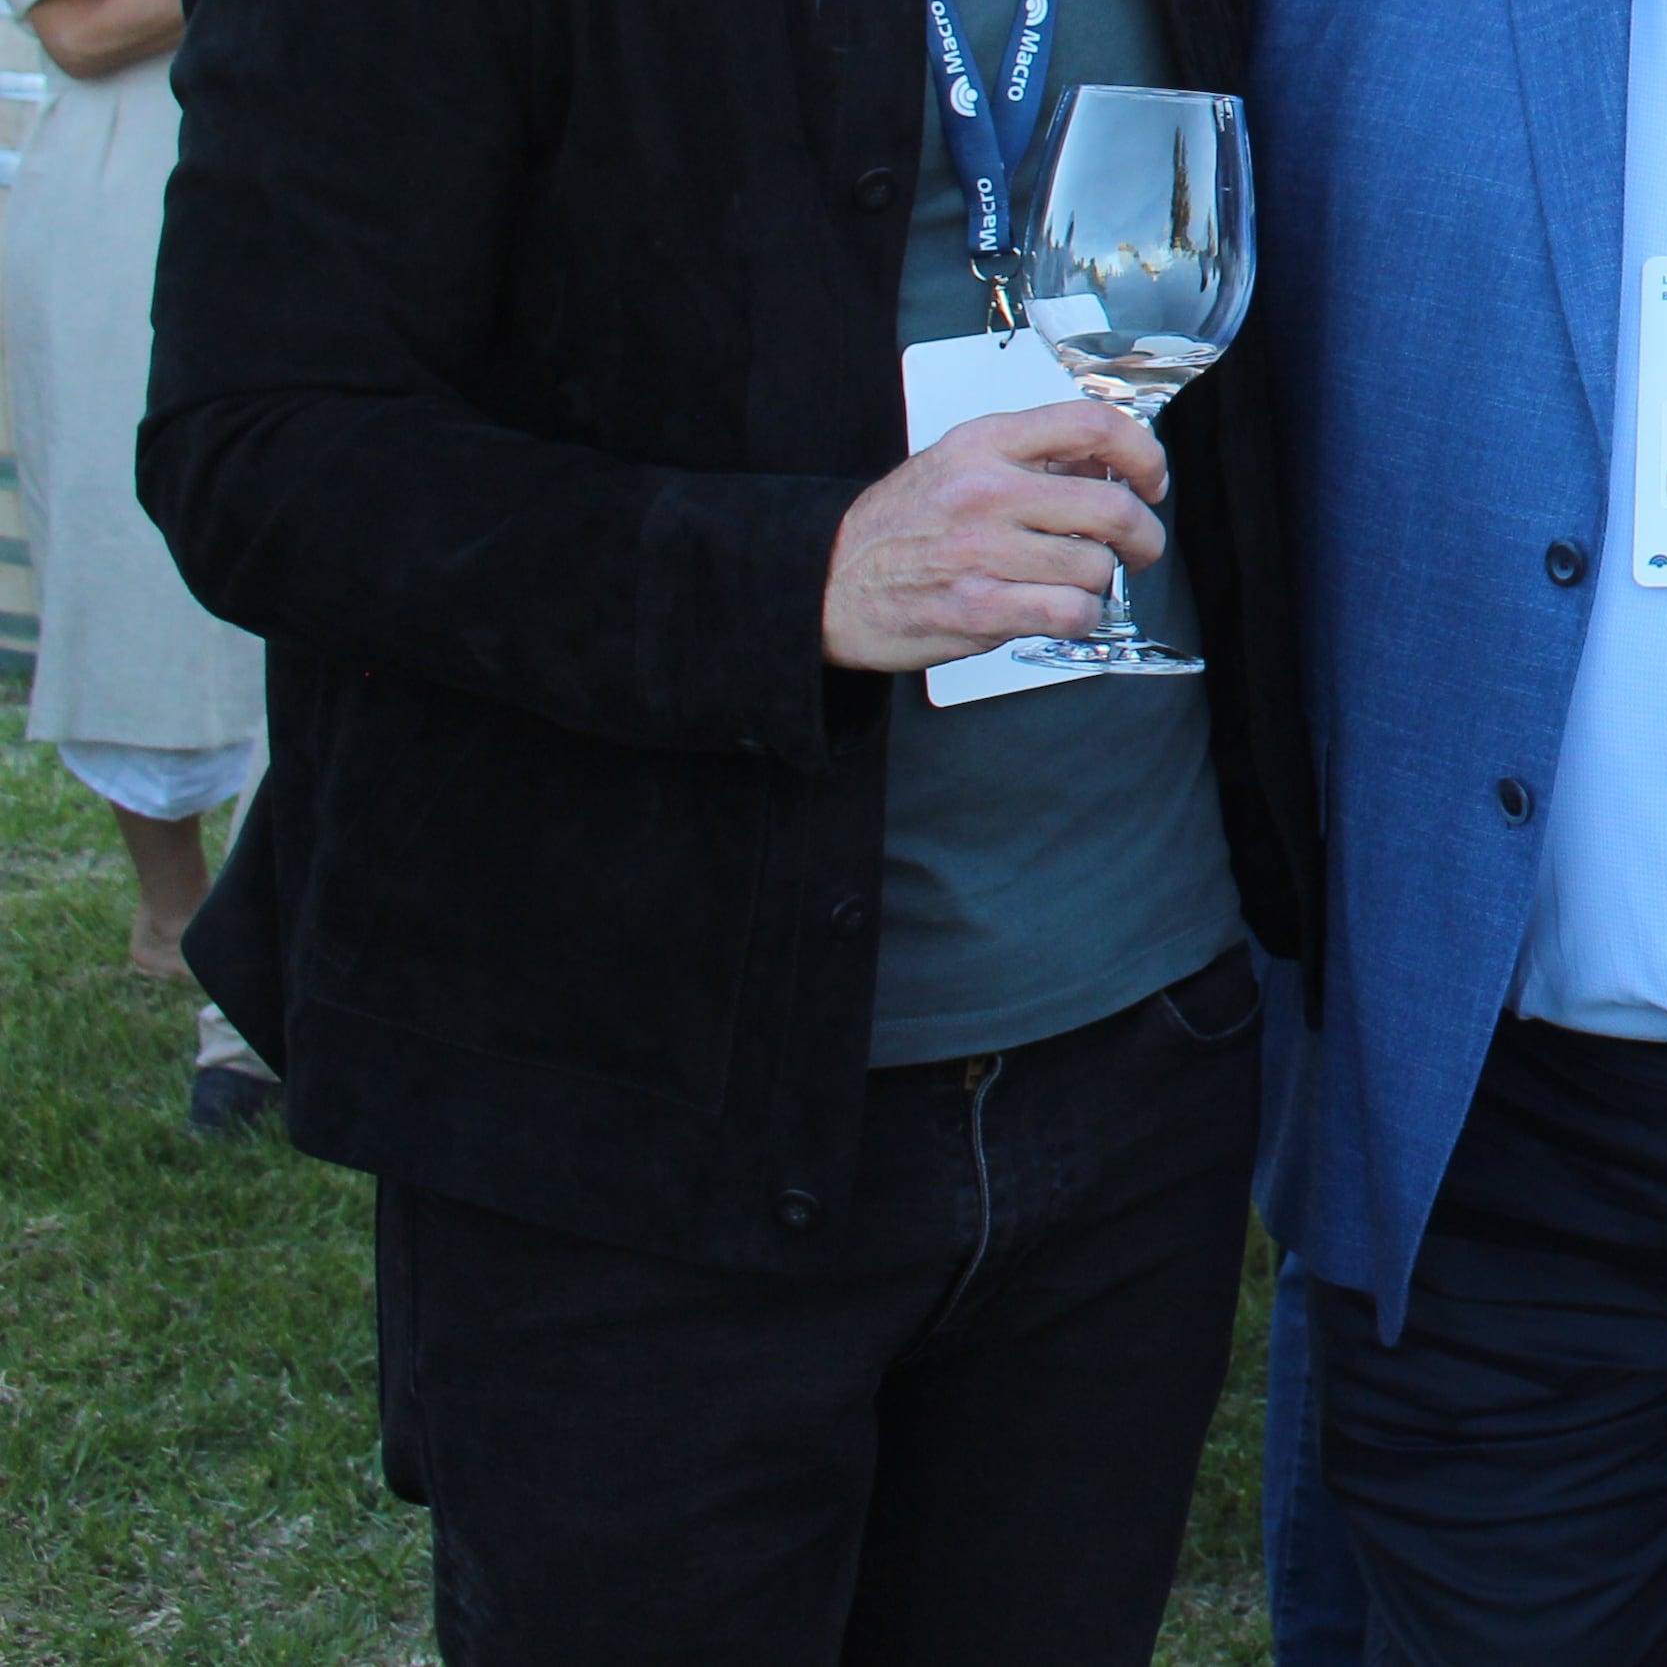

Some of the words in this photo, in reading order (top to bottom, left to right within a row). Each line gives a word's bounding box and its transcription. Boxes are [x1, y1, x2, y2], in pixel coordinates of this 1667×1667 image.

[931, 0, 965, 74] Macro
[1007, 29, 1040, 102] Macro
[976, 177, 998, 252] Macro
